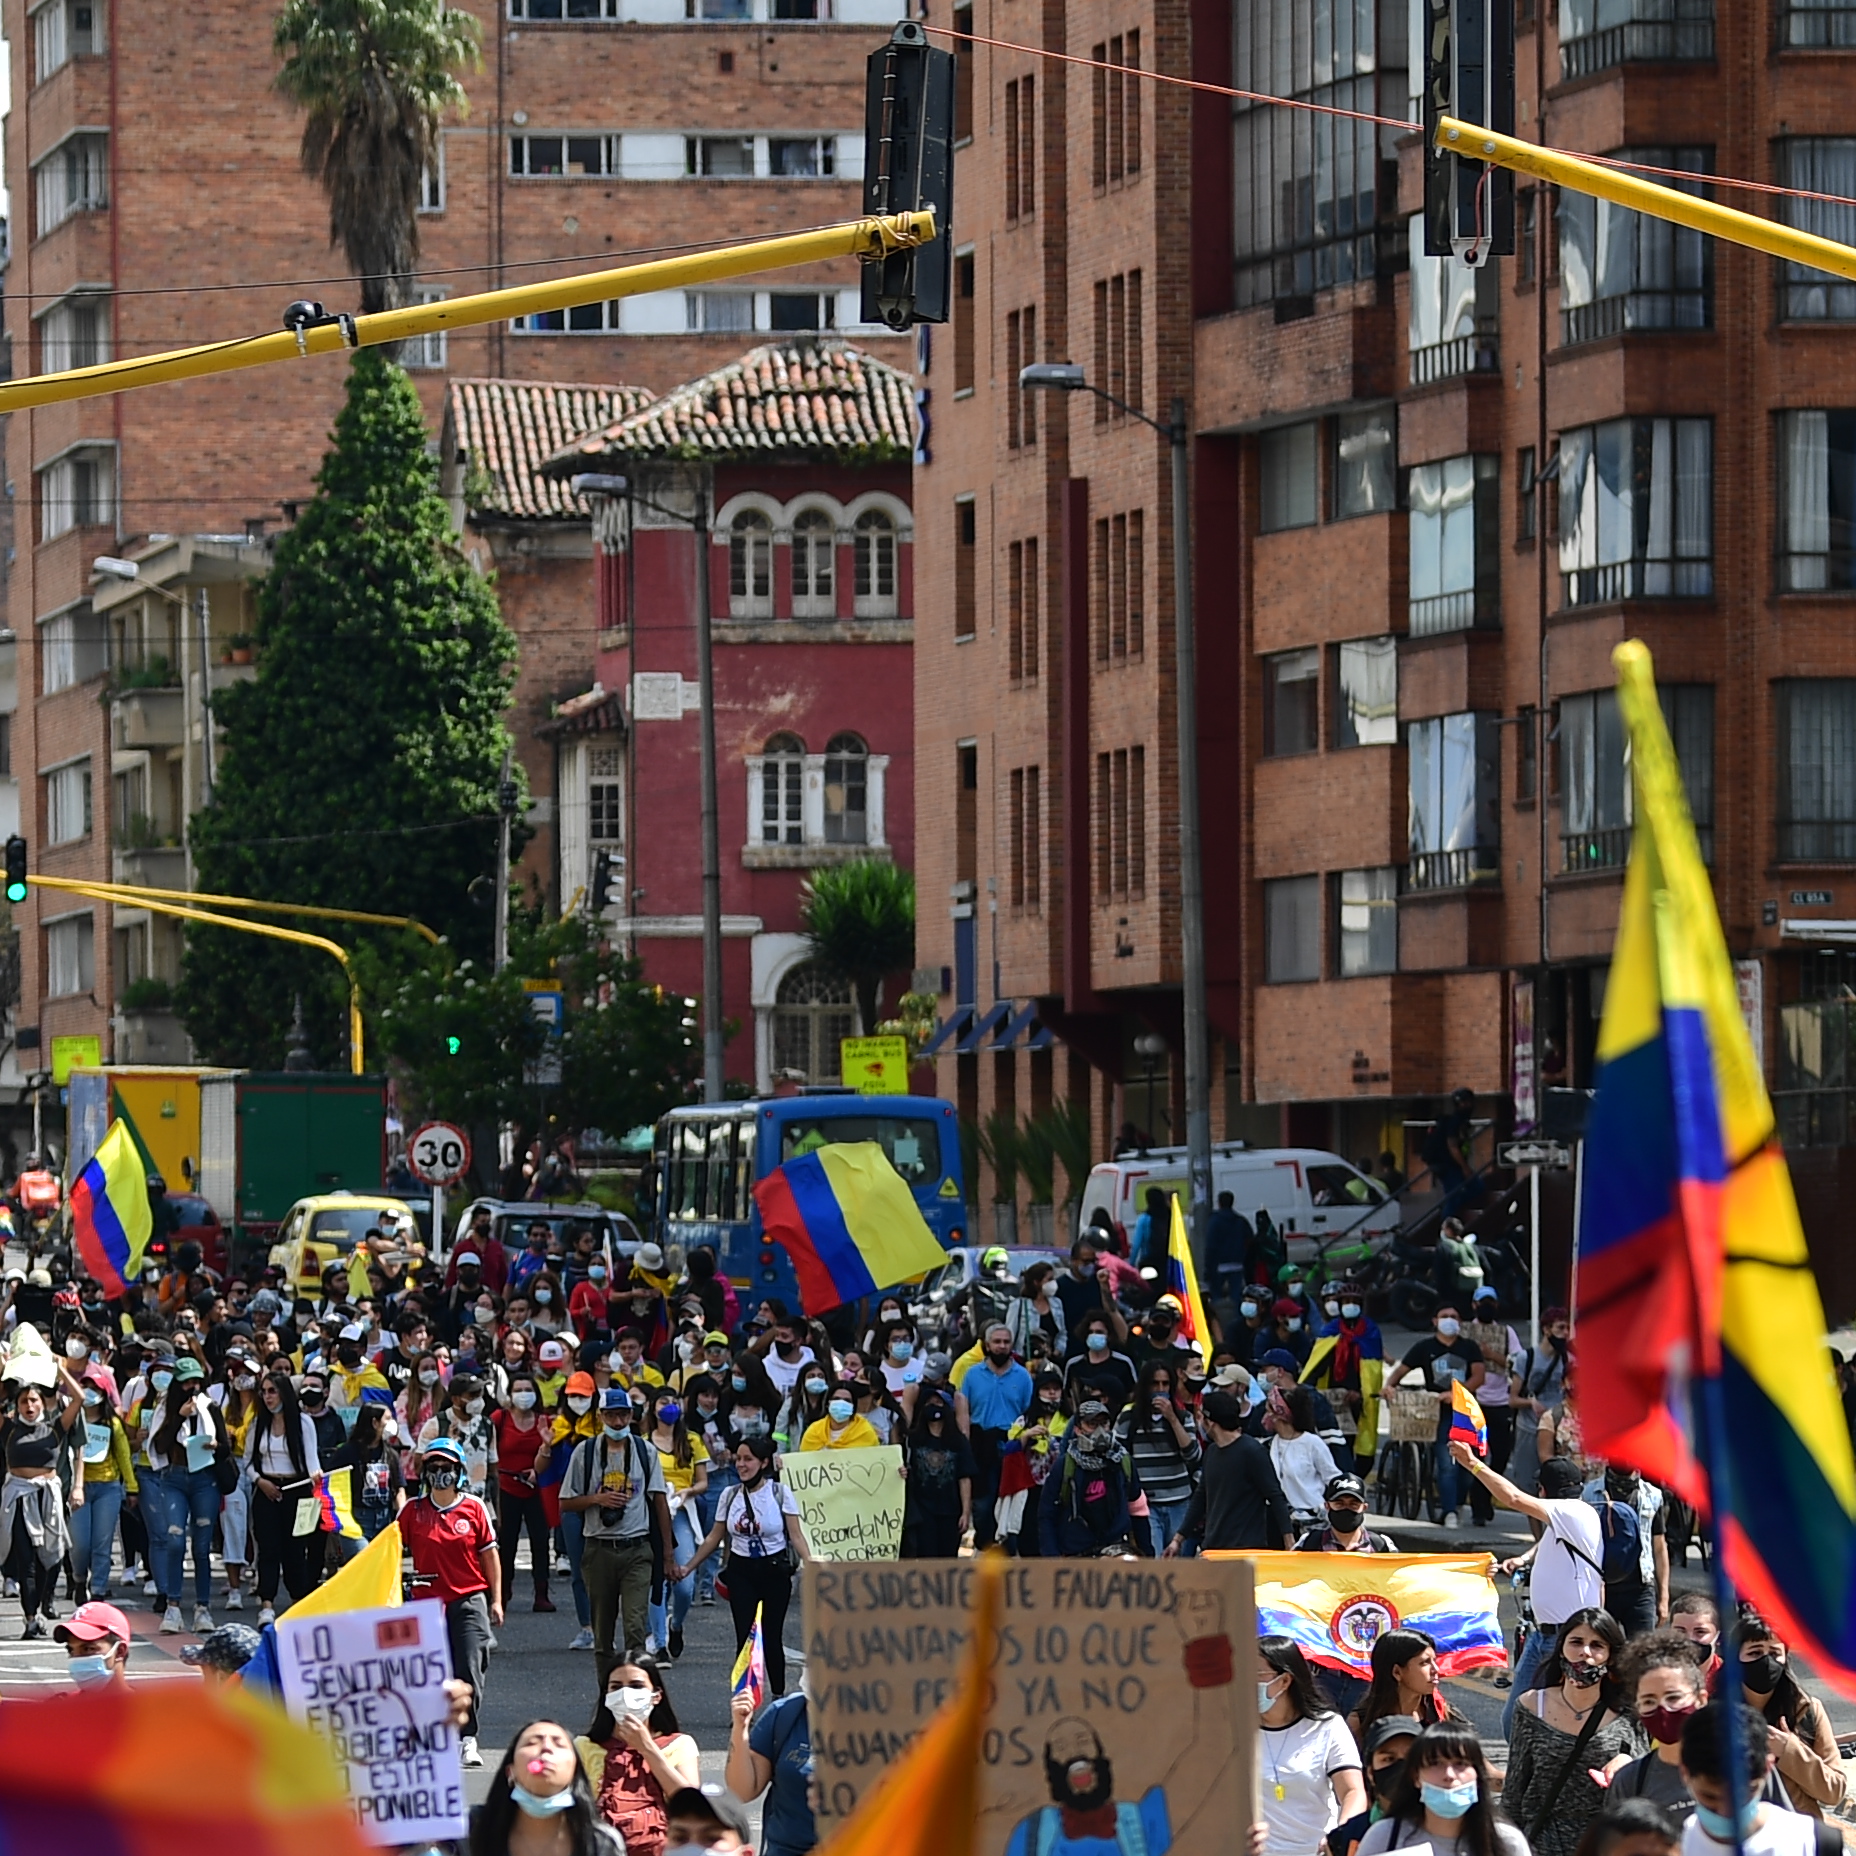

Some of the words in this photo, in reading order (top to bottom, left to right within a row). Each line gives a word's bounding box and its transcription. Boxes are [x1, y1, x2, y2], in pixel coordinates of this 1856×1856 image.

[418, 1140, 462, 1168] 30
[786, 1462, 843, 1492] LUCAS
[815, 1569, 976, 1613] RESIDENTE
[1003, 1568, 1034, 1609] TE
[292, 1624, 333, 1667] LO
[1034, 1626, 1071, 1665] LO
[1081, 1624, 1161, 1667] QUE
[301, 1650, 445, 1700] SENTIMOS
[812, 1682, 890, 1715] VINO
[1017, 1677, 1062, 1716] YA
[1081, 1676, 1148, 1714] NO
[331, 1720, 450, 1764] OBIERNO
[369, 1754, 436, 1790] ESTA
